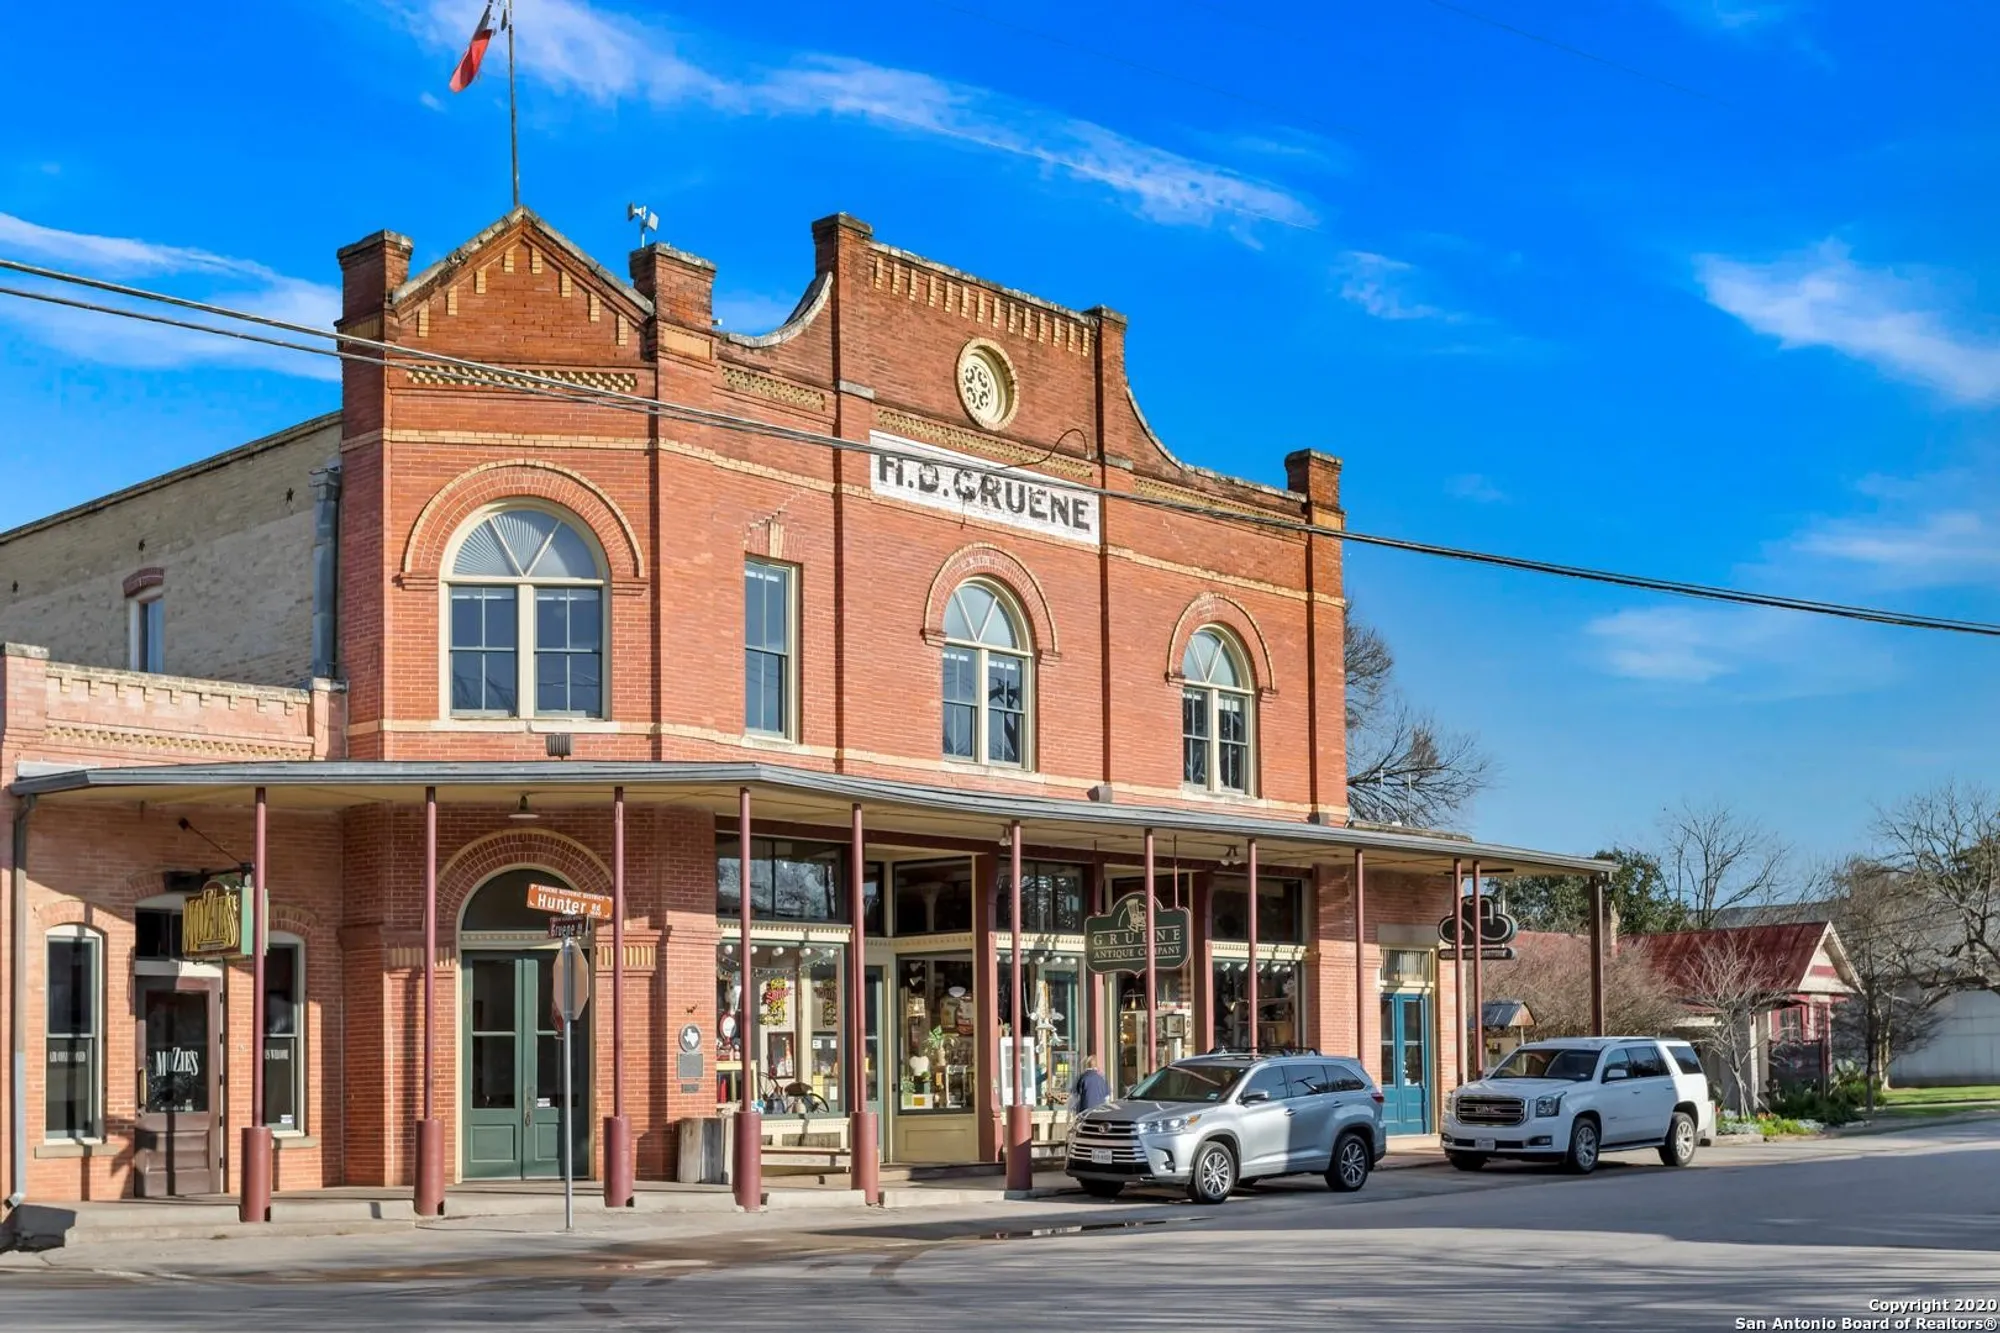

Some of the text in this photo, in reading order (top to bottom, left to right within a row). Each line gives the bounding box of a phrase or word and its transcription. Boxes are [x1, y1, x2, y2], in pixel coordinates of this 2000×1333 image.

[953, 469, 1090, 531] GRUENE
[538, 893, 587, 914] Hunter
[1093, 929, 1181, 945] GRUENE
[1094, 949, 1135, 960] ANTIQUE
